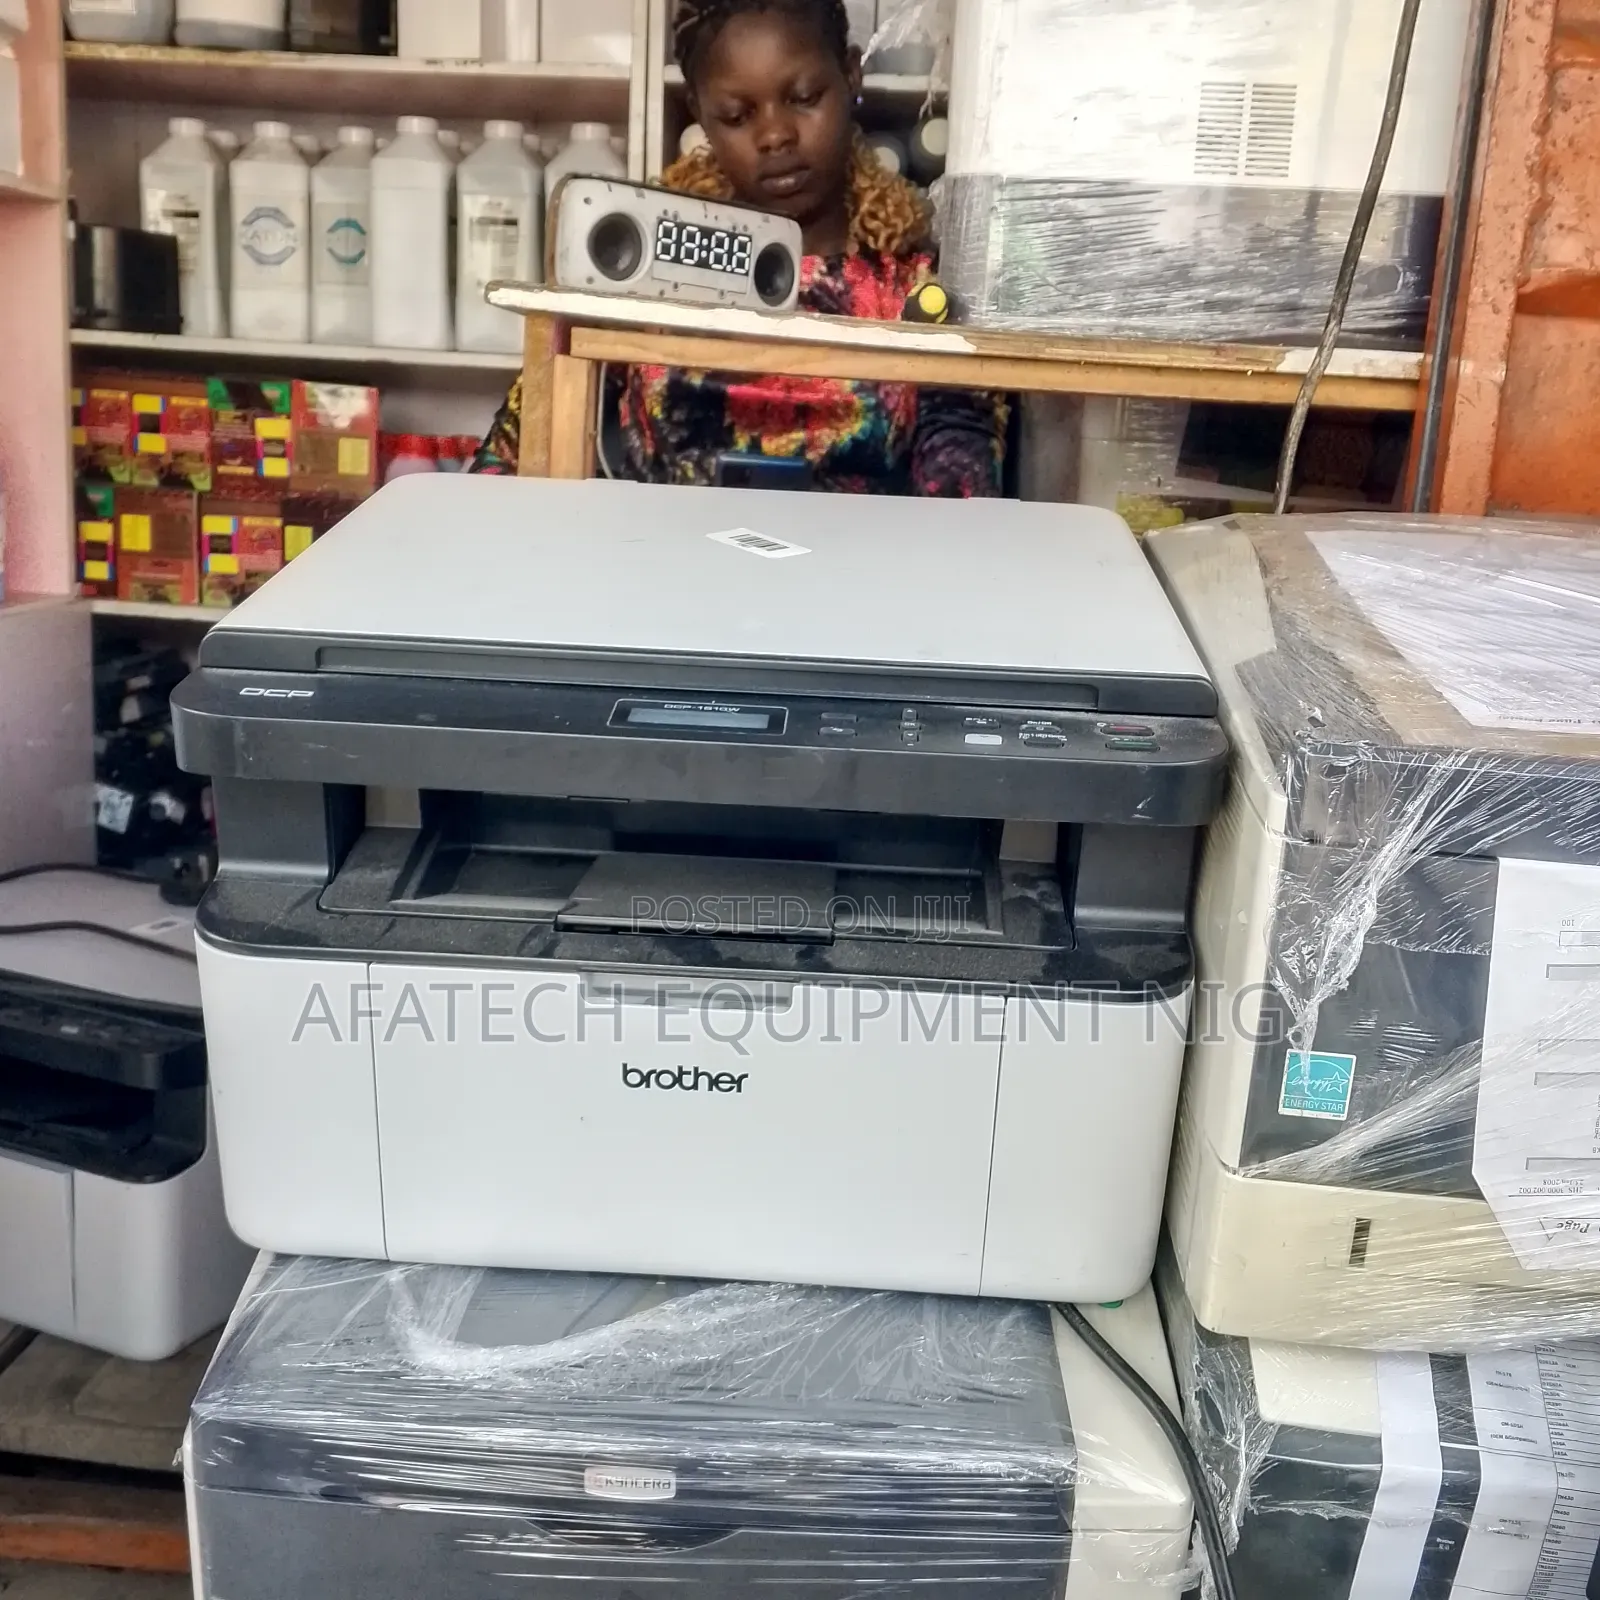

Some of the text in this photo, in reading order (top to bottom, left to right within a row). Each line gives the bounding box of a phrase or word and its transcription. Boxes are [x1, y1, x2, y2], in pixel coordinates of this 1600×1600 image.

[239, 686, 314, 698] DCP
[1561, 919, 1575, 927] 100
[622, 1063, 749, 1093] brother
[1284, 1099, 1344, 1112] ENERGY STAR
[1555, 1220, 1591, 1234] Page
[604, 1477, 671, 1490] KYOCERA
